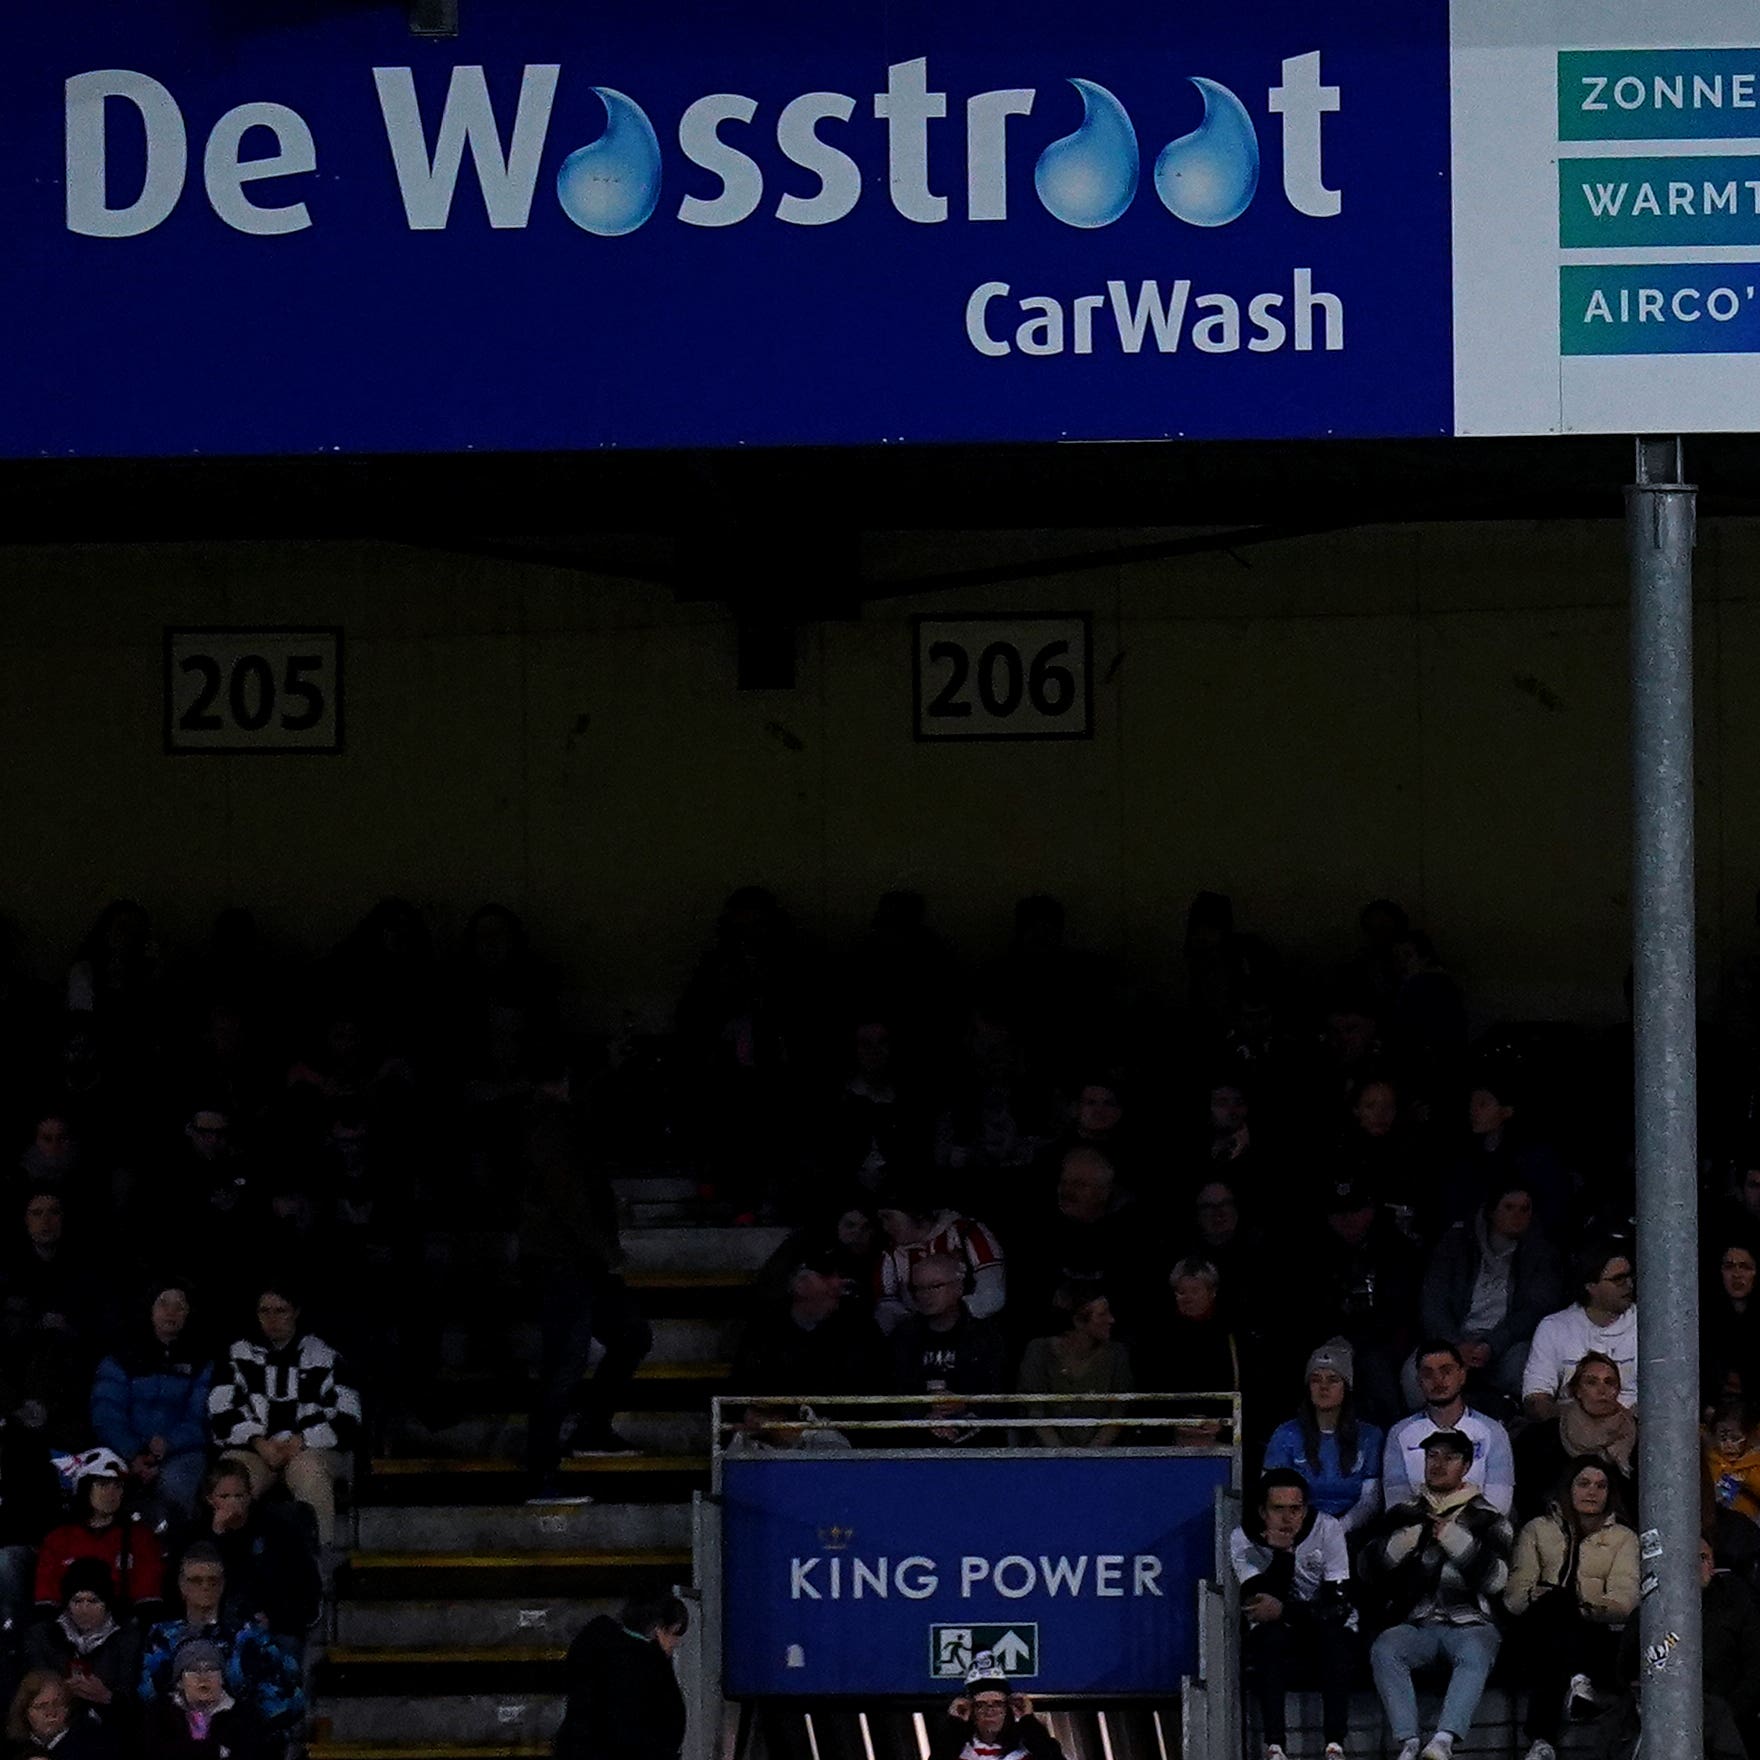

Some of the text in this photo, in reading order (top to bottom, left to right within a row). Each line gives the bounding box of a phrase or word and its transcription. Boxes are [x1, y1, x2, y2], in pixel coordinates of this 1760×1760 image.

[64, 66, 318, 240] De
[964, 266, 1345, 358] CarWash
[176, 652, 326, 732] 205
[925, 639, 1077, 718] 206
[790, 1554, 1164, 1600] KING POWER
